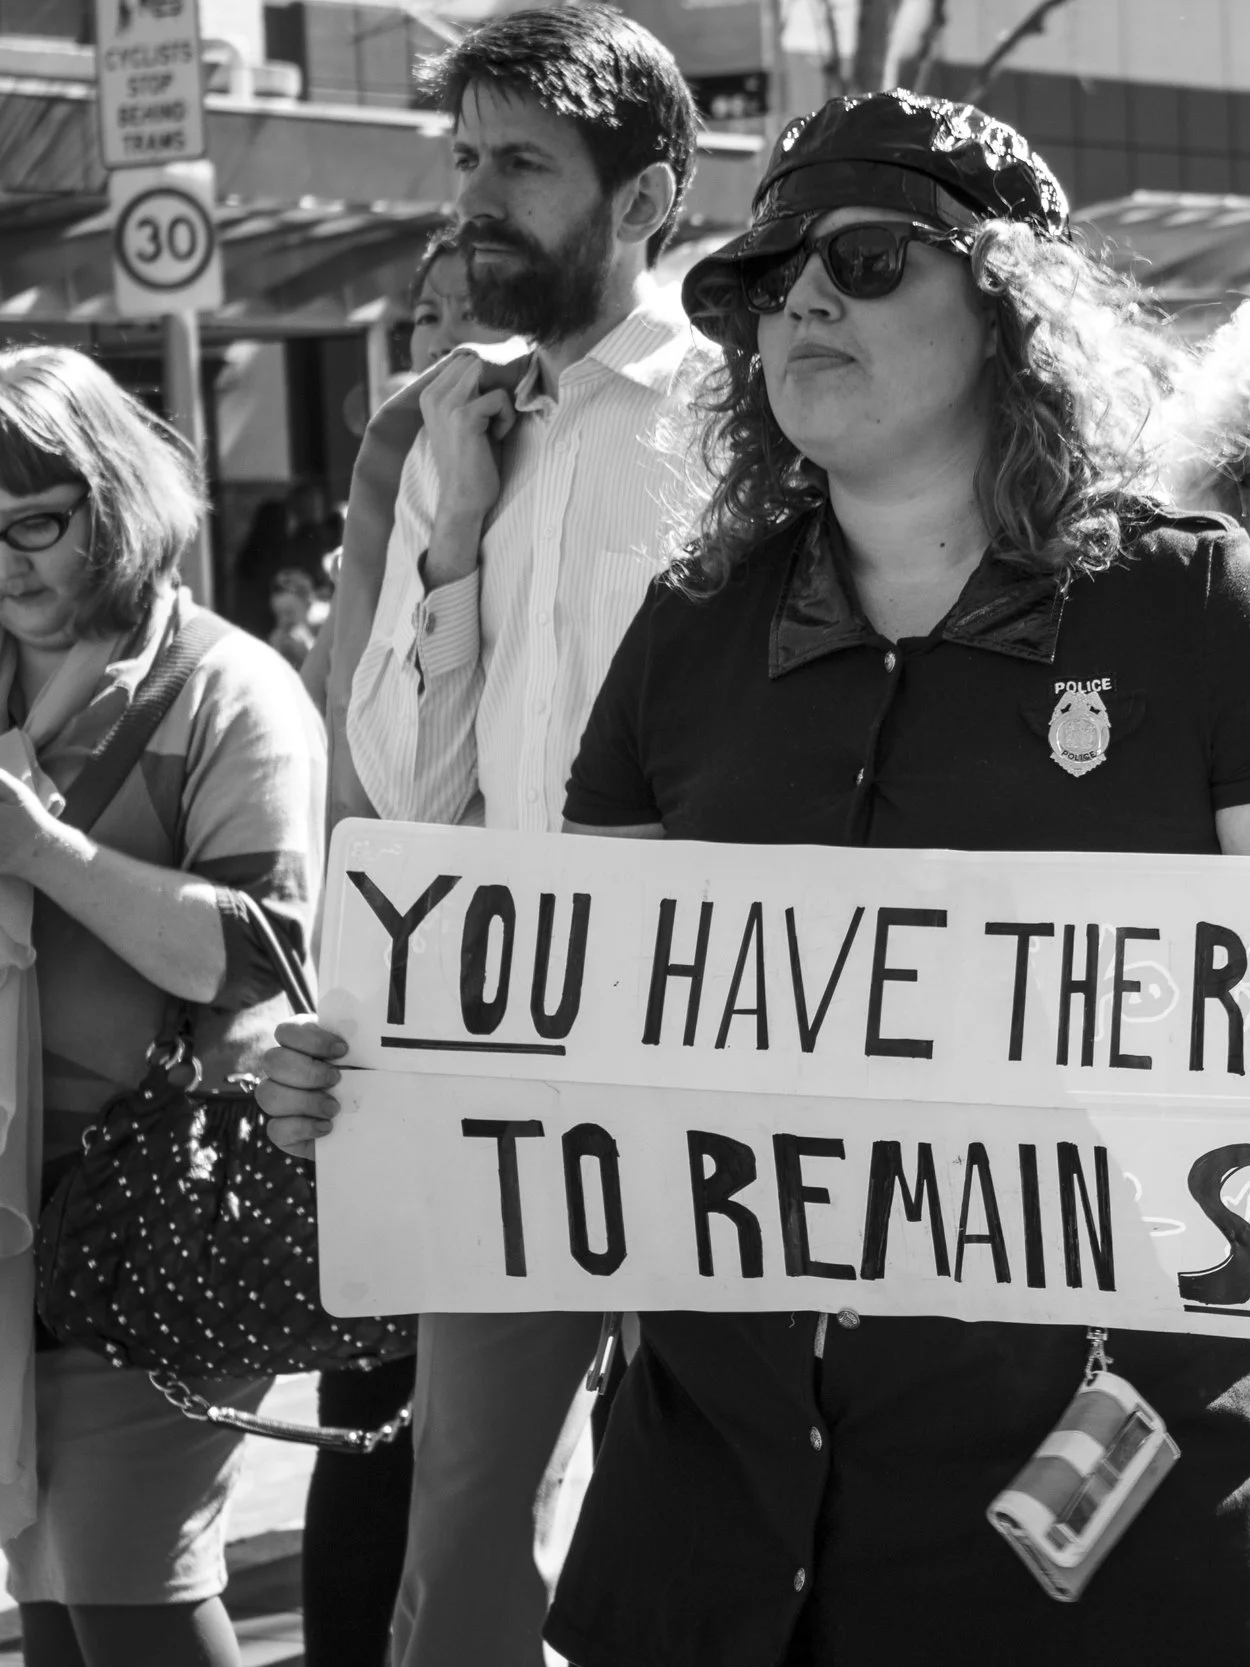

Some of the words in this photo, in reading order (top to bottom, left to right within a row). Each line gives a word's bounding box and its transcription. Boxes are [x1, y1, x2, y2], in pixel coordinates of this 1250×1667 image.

[105, 41, 193, 71] CYCLISTS
[127, 73, 174, 97] STOP
[117, 101, 186, 128] BEHIND
[123, 130, 186, 154] TRAMS
[135, 215, 198, 263] 30
[1054, 677, 1112, 694] POLICE
[1061, 750, 1097, 762] POLICE
[346, 870, 591, 1040] YOU
[641, 898, 948, 1060] HAVE
[984, 922, 1161, 1070] THE
[461, 1118, 628, 1278] TO
[686, 1129, 1117, 1292] REMAIN
